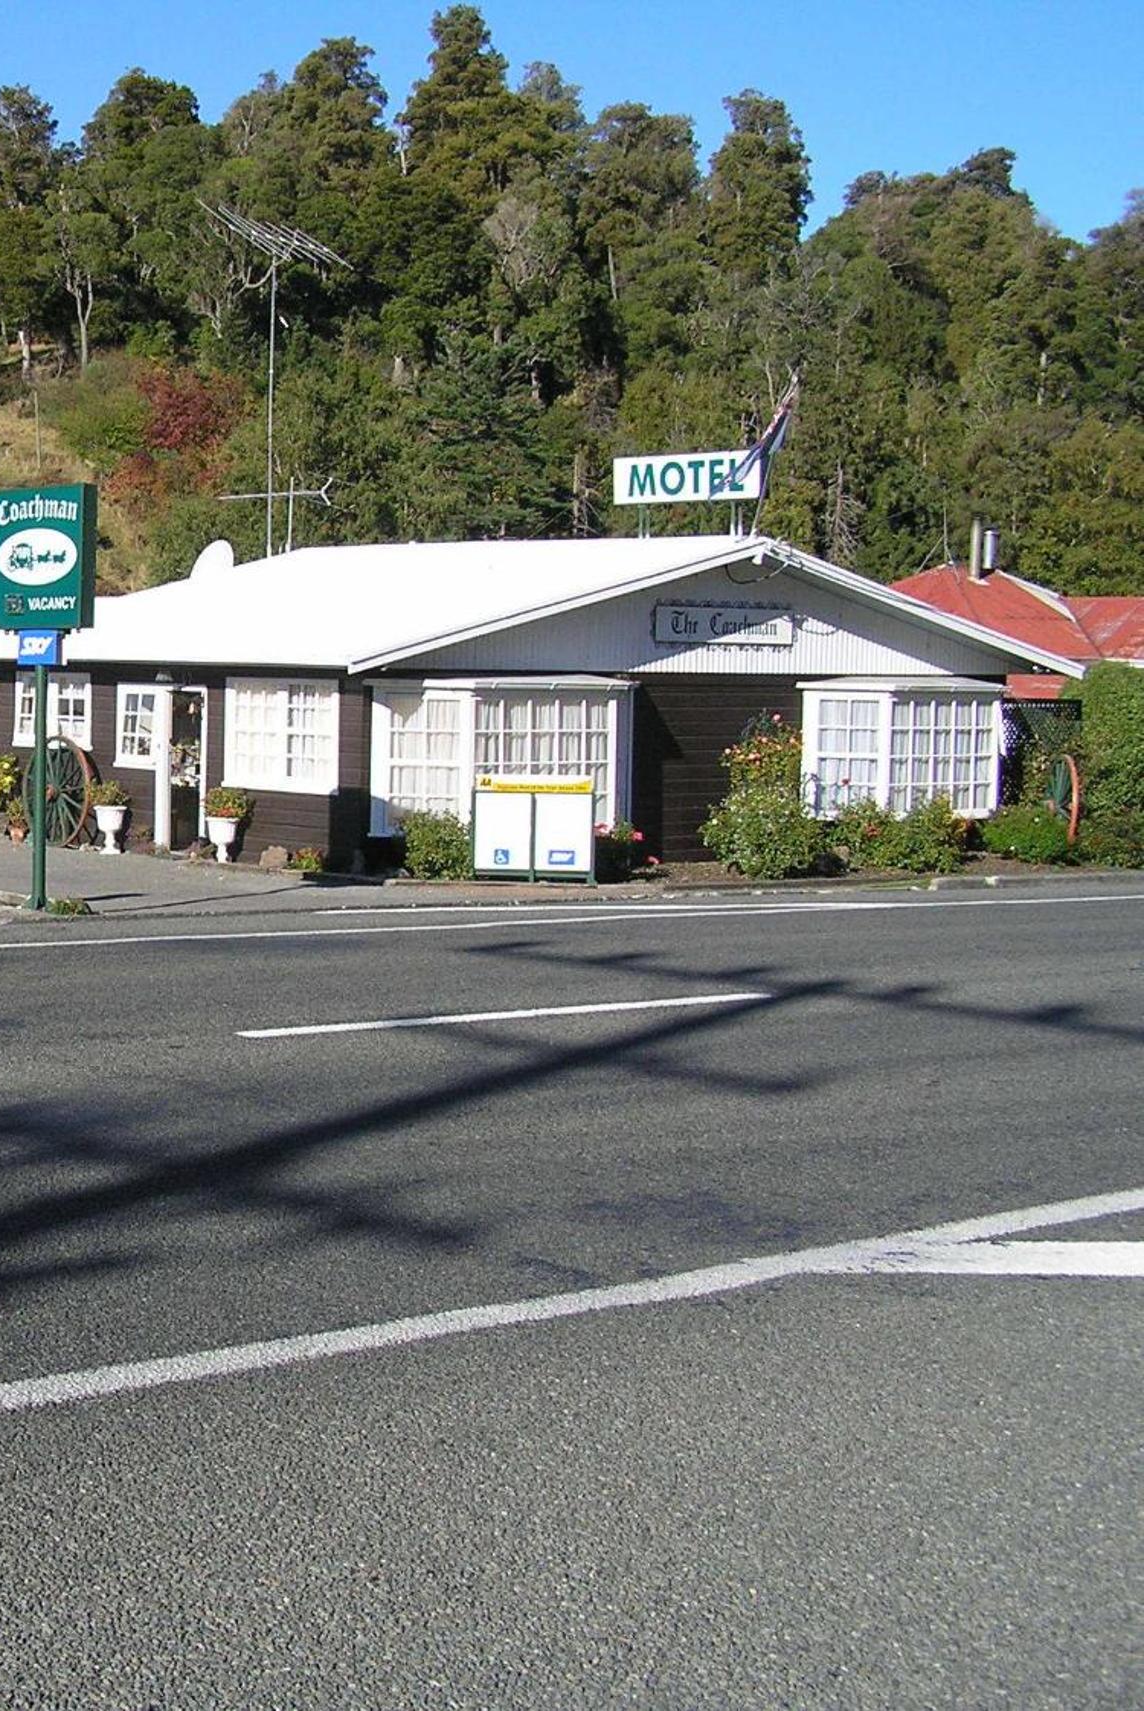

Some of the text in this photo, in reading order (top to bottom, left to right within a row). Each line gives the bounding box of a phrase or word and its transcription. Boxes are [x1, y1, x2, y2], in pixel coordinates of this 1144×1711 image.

[628, 458, 745, 497] MOTEL
[27, 596, 77, 612] VACANCY
[670, 610, 778, 637] The Coachman
